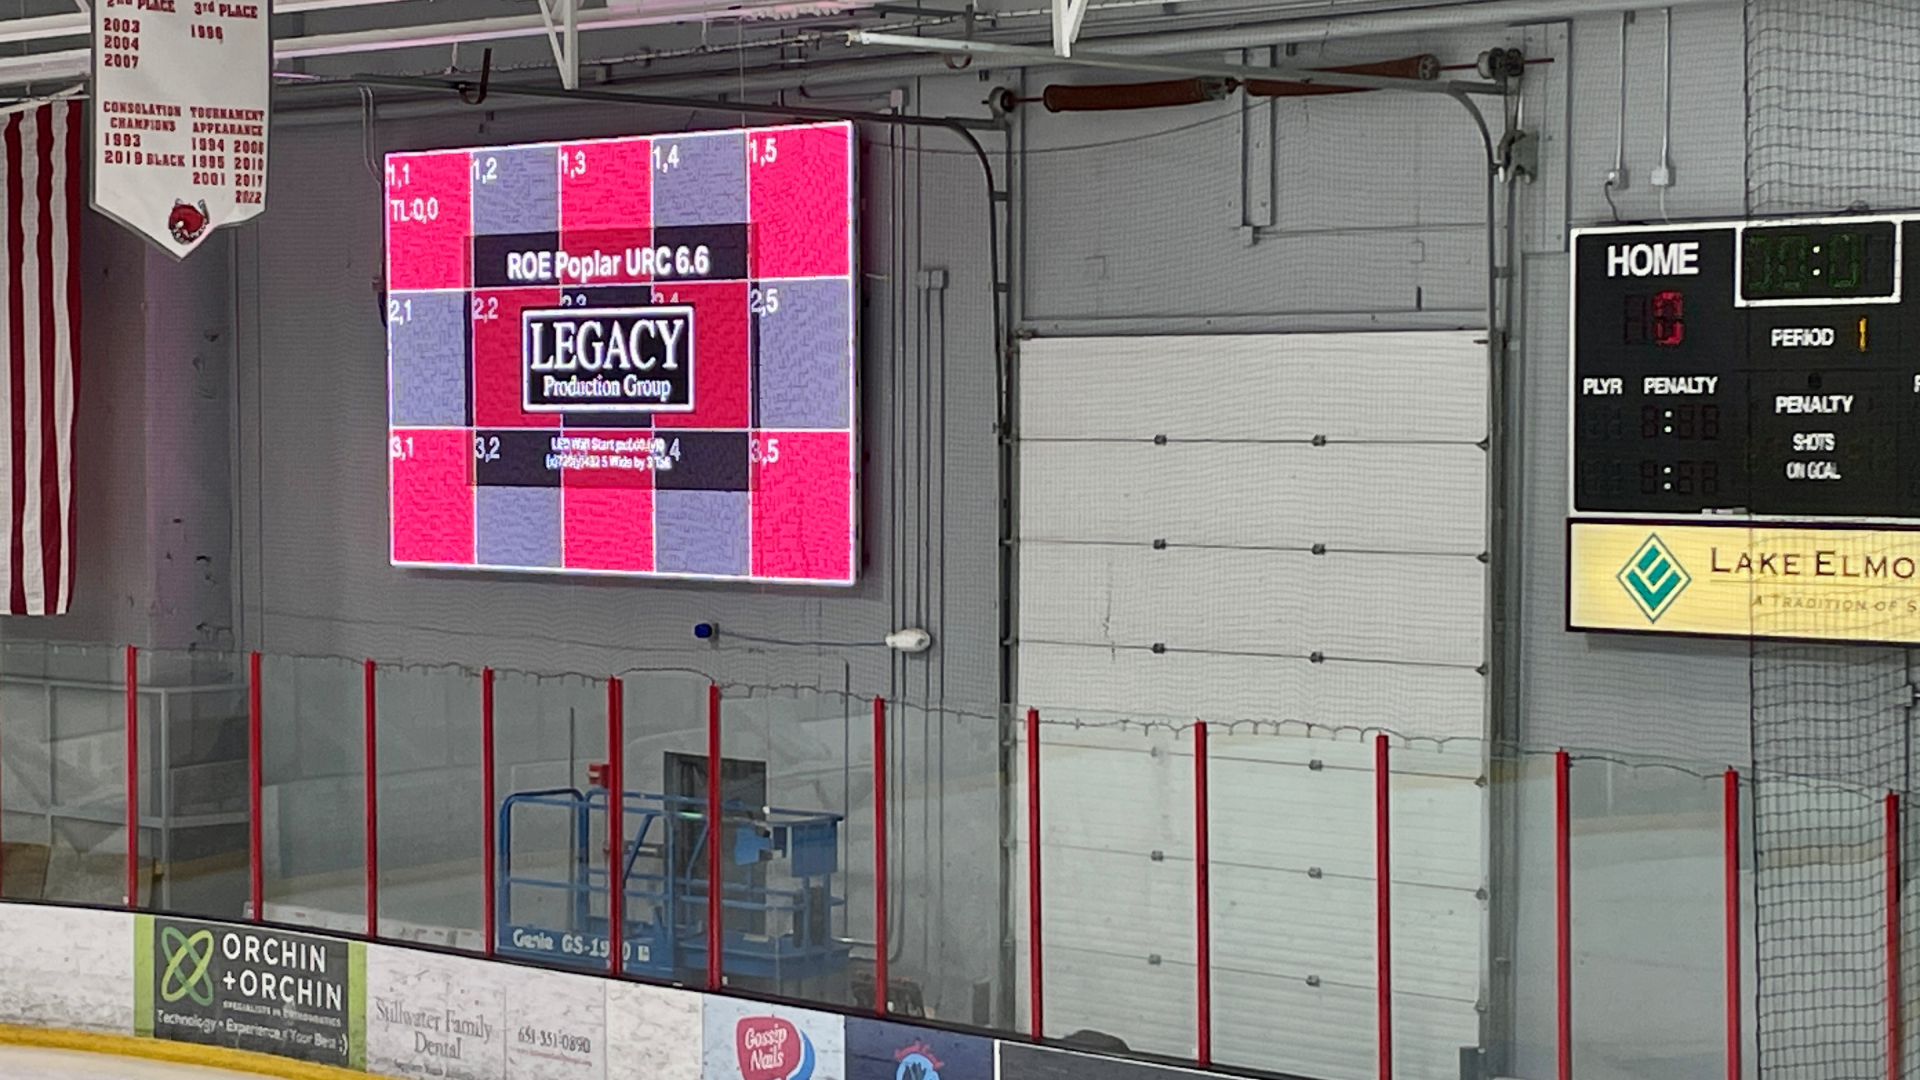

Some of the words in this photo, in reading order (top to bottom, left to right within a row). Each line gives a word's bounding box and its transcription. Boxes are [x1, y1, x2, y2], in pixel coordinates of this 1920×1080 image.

[194, 1, 215, 16] 3rd
[219, 4, 259, 19] PLACE
[103, 17, 141, 33] 2003
[104, 35, 139, 51] 2004
[104, 53, 139, 69] 2007
[103, 100, 182, 118] CONSOLATION
[189, 106, 265, 122] TOURNAMENT
[110, 117, 176, 132] CHAMPIONS
[192, 122, 263, 137] APPEARANCE
[104, 133, 141, 147] 1993
[191, 137, 225, 153] 1994
[750, 138, 778, 166] 1,5
[104, 150, 143, 165] 2019
[146, 153, 186, 167] BLACK
[473, 157, 498, 184] 1,2
[562, 151, 586, 179] 1,3
[653, 144, 679, 174] 1,4
[192, 172, 226, 186] 2001
[235, 174, 263, 187] 2017
[388, 163, 411, 188] 1,1
[507, 251, 552, 280] ROE
[555, 249, 622, 283] Poplar
[625, 246, 672, 276] URC
[675, 245, 709, 274] 6.6
[1607, 242, 1699, 277] HOME
[390, 299, 412, 325] 2,1
[473, 297, 499, 323] 2,2
[751, 288, 779, 317] 2,5
[530, 319, 684, 371] LEGACY
[1771, 328, 1835, 347] PERIOD
[1858, 317, 1867, 352] 1
[543, 374, 621, 398] Production
[623, 374, 671, 402] Group
[1583, 377, 1623, 395] PLYR
[1643, 376, 1718, 395] PENALTY
[1775, 395, 1854, 414] PENALTY
[390, 437, 413, 461] 3,1
[475, 437, 500, 462] 3,2
[1792, 433, 1836, 452] SHOTS
[1786, 462, 1805, 479] ON
[1806, 462, 1842, 480] GOAL
[1710, 547, 1801, 576] LAKE
[1815, 550, 1916, 579] ELMO
[1773, 594, 1867, 611] TRADITION
[222, 933, 326, 973] ORCHIN
[513, 928, 554, 950] Genie
[562, 934, 631, 961] GS-190
[157, 1009, 217, 1034] Technology
[226, 1018, 280, 1040] Experience
[375, 997, 441, 1033] Stillwater
[445, 1009, 493, 1045] Family
[414, 1031, 462, 1060] Dental
[517, 1025, 592, 1054] 651-351-0890
[744, 1024, 788, 1051] Gossip
[750, 1048, 784, 1072] Nails
